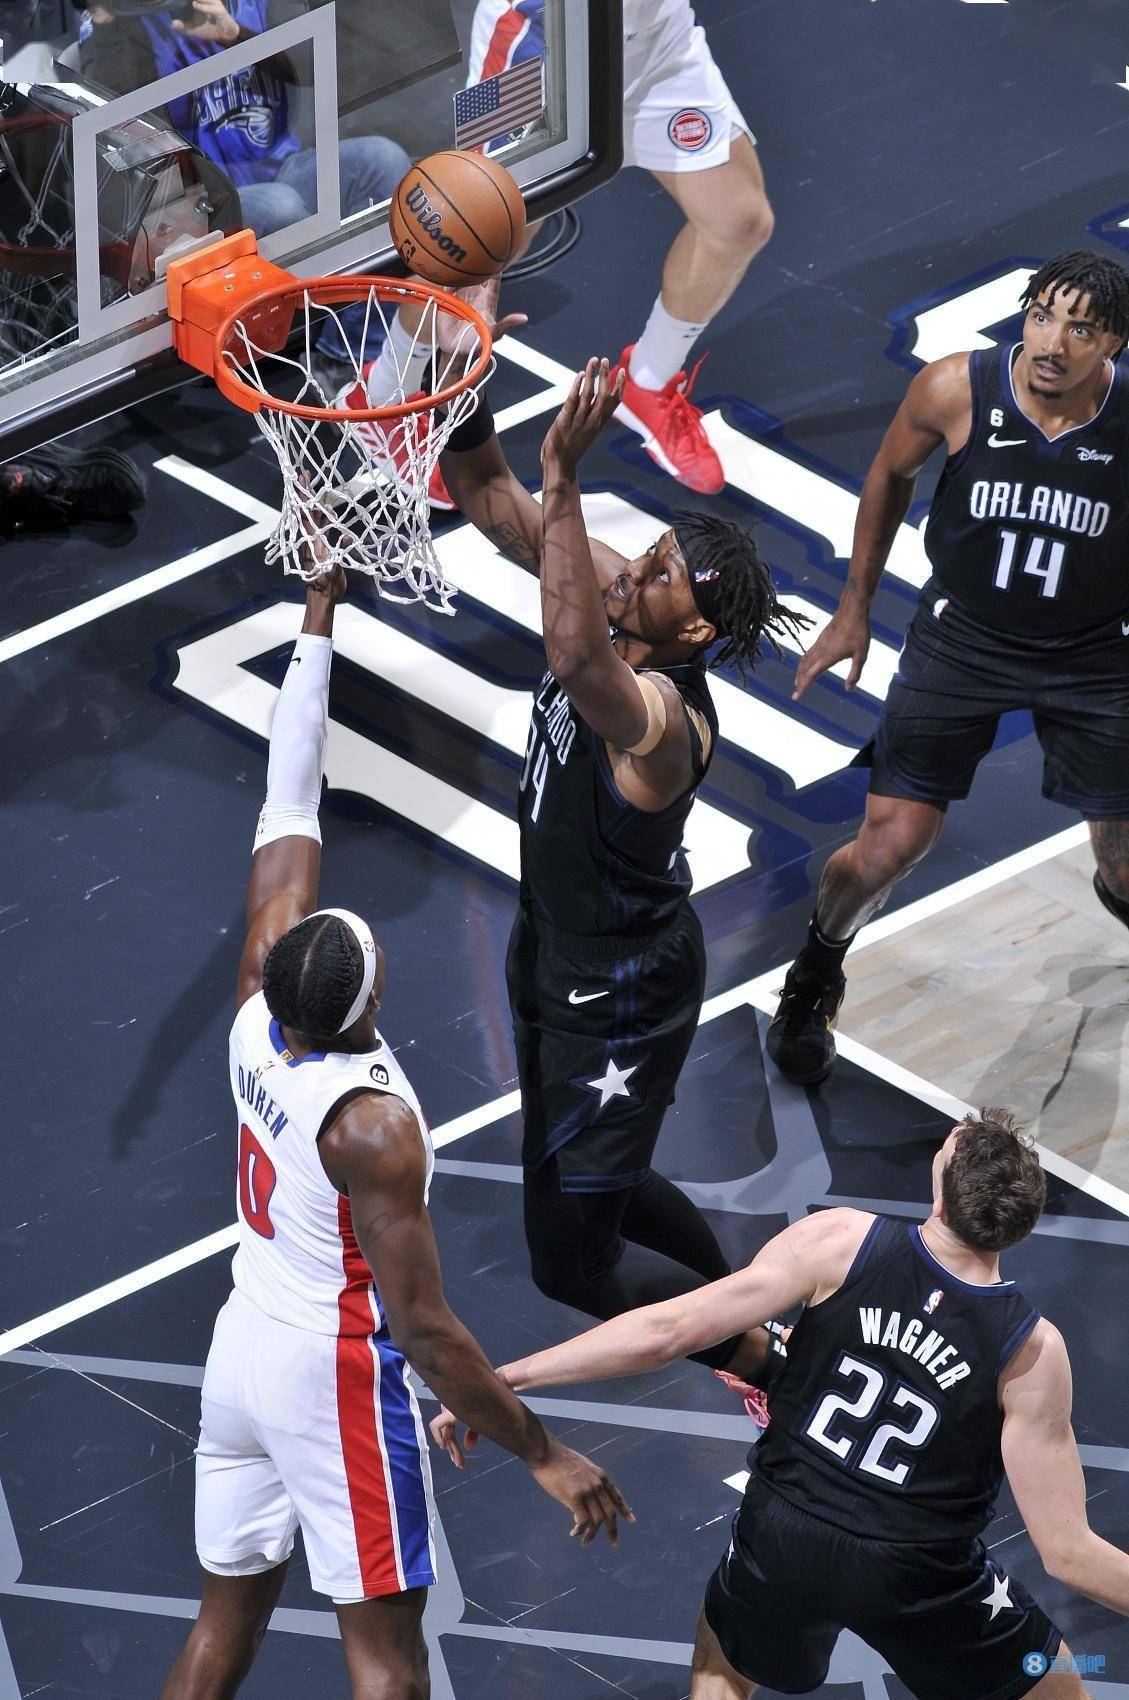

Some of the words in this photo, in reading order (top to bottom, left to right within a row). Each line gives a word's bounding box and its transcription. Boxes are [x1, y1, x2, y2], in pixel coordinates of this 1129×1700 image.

[406, 182, 467, 263] Wilson
[990, 408, 1004, 427] 6
[1076, 446, 1114, 465] Disney
[970, 480, 1110, 537] ORLANDO
[995, 530, 1066, 598] 14
[536, 670, 577, 765] LANDO
[238, 1063, 289, 1141] DUREN
[239, 1123, 276, 1240] 0
[859, 1307, 971, 1390] WAGNER
[806, 1356, 938, 1485] 22
